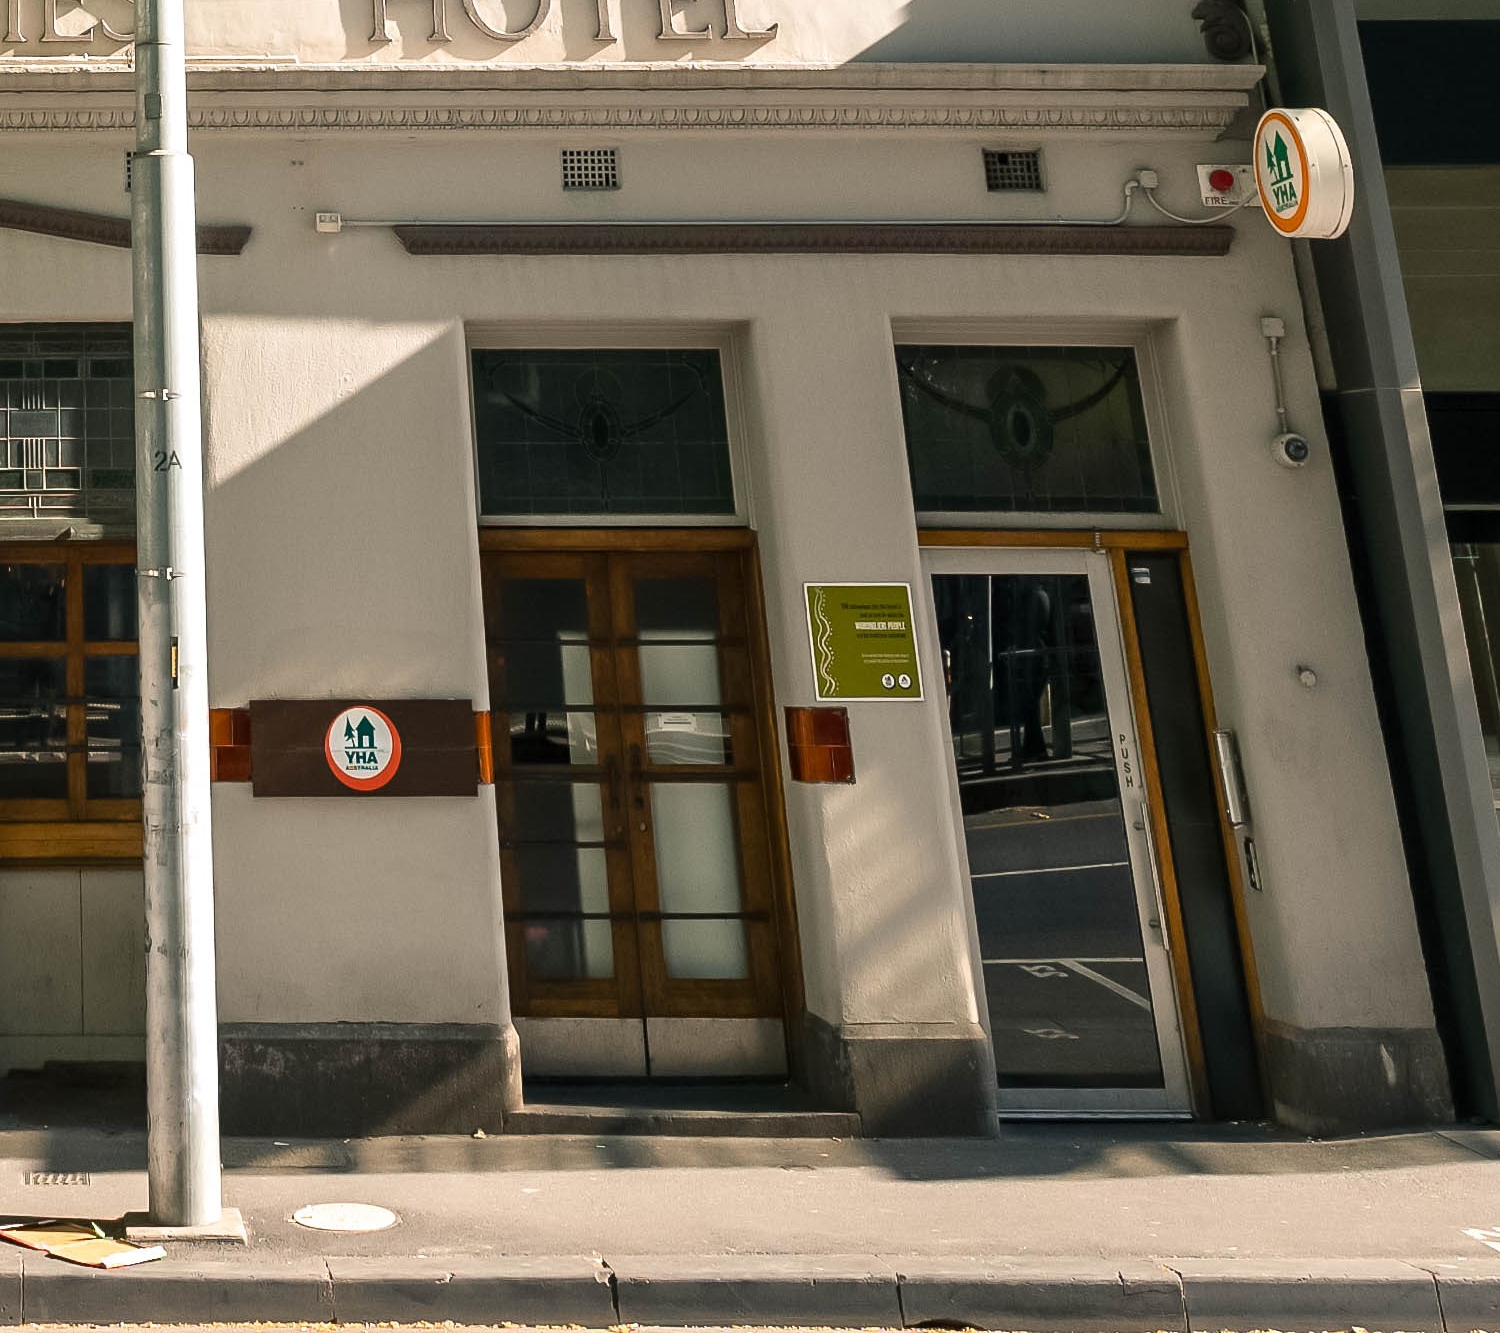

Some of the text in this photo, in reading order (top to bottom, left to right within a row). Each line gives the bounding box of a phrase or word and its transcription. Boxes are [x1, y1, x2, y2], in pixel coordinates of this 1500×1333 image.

[1205, 196, 1227, 205] FIRE
[1272, 181, 1298, 206] YHA
[154, 450, 183, 471] 2A
[344, 750, 378, 764] YHA
[1119, 733, 1134, 788] PUSH
